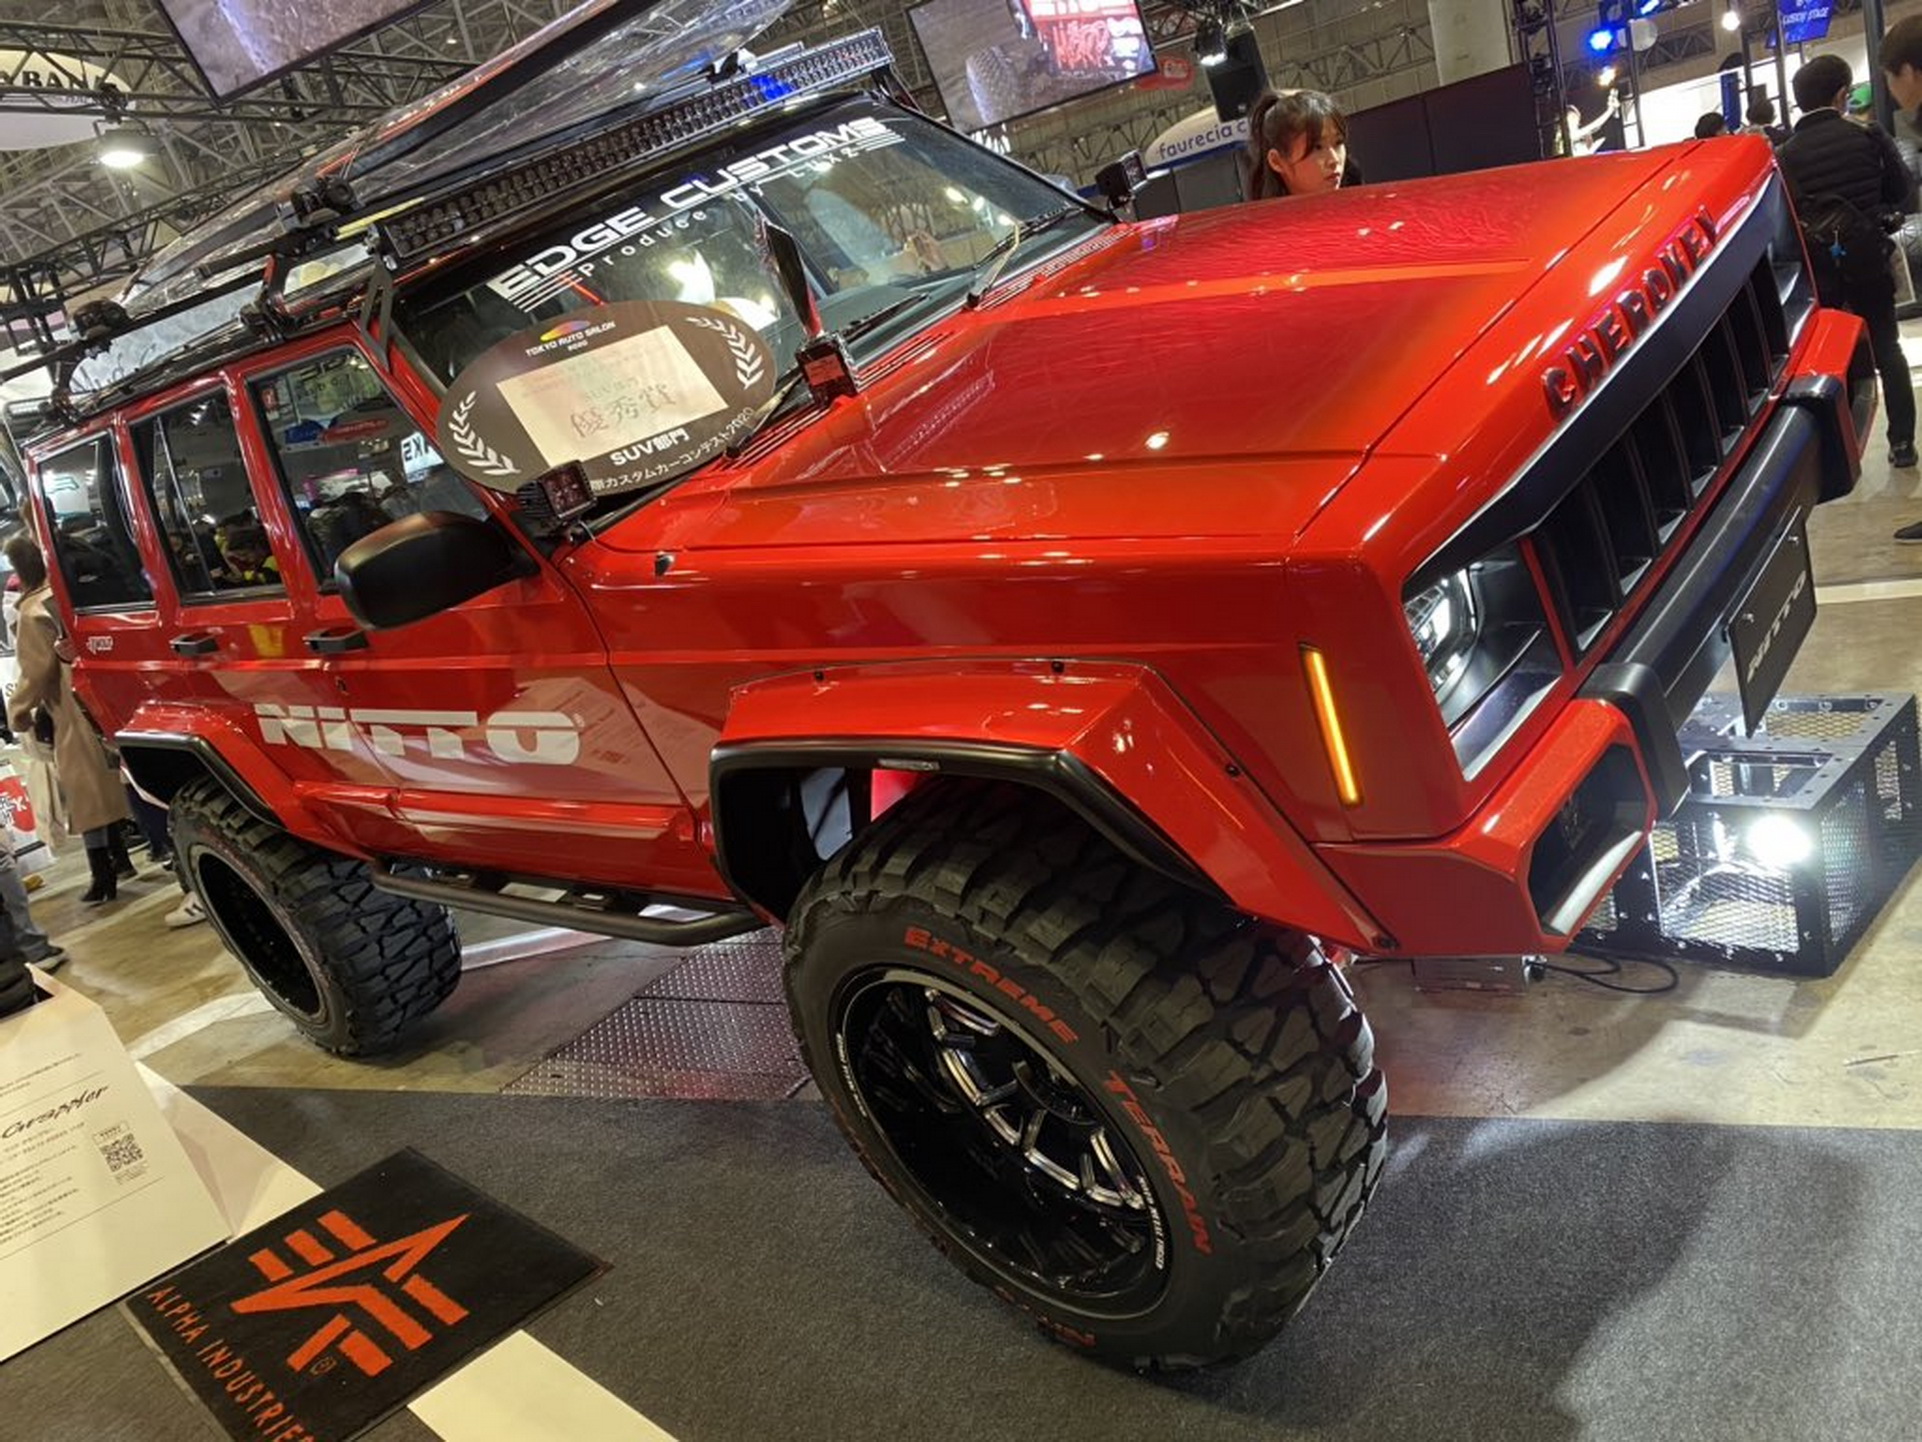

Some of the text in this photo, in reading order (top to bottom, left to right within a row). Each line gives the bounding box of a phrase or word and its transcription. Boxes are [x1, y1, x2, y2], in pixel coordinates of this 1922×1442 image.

[1157, 124, 1233, 160] faurecia
[486, 116, 888, 301] EDGE CUSTOMS
[577, 209, 708, 277] Produce
[525, 320, 618, 357] TOKYO AUTO SALON
[610, 426, 691, 467] SUV部門
[1746, 569, 1808, 684] NITTO
[253, 702, 581, 766] NITTO
[1103, 1069, 1214, 1255] TERRAIN
[147, 1285, 210, 1345] ALPHA
